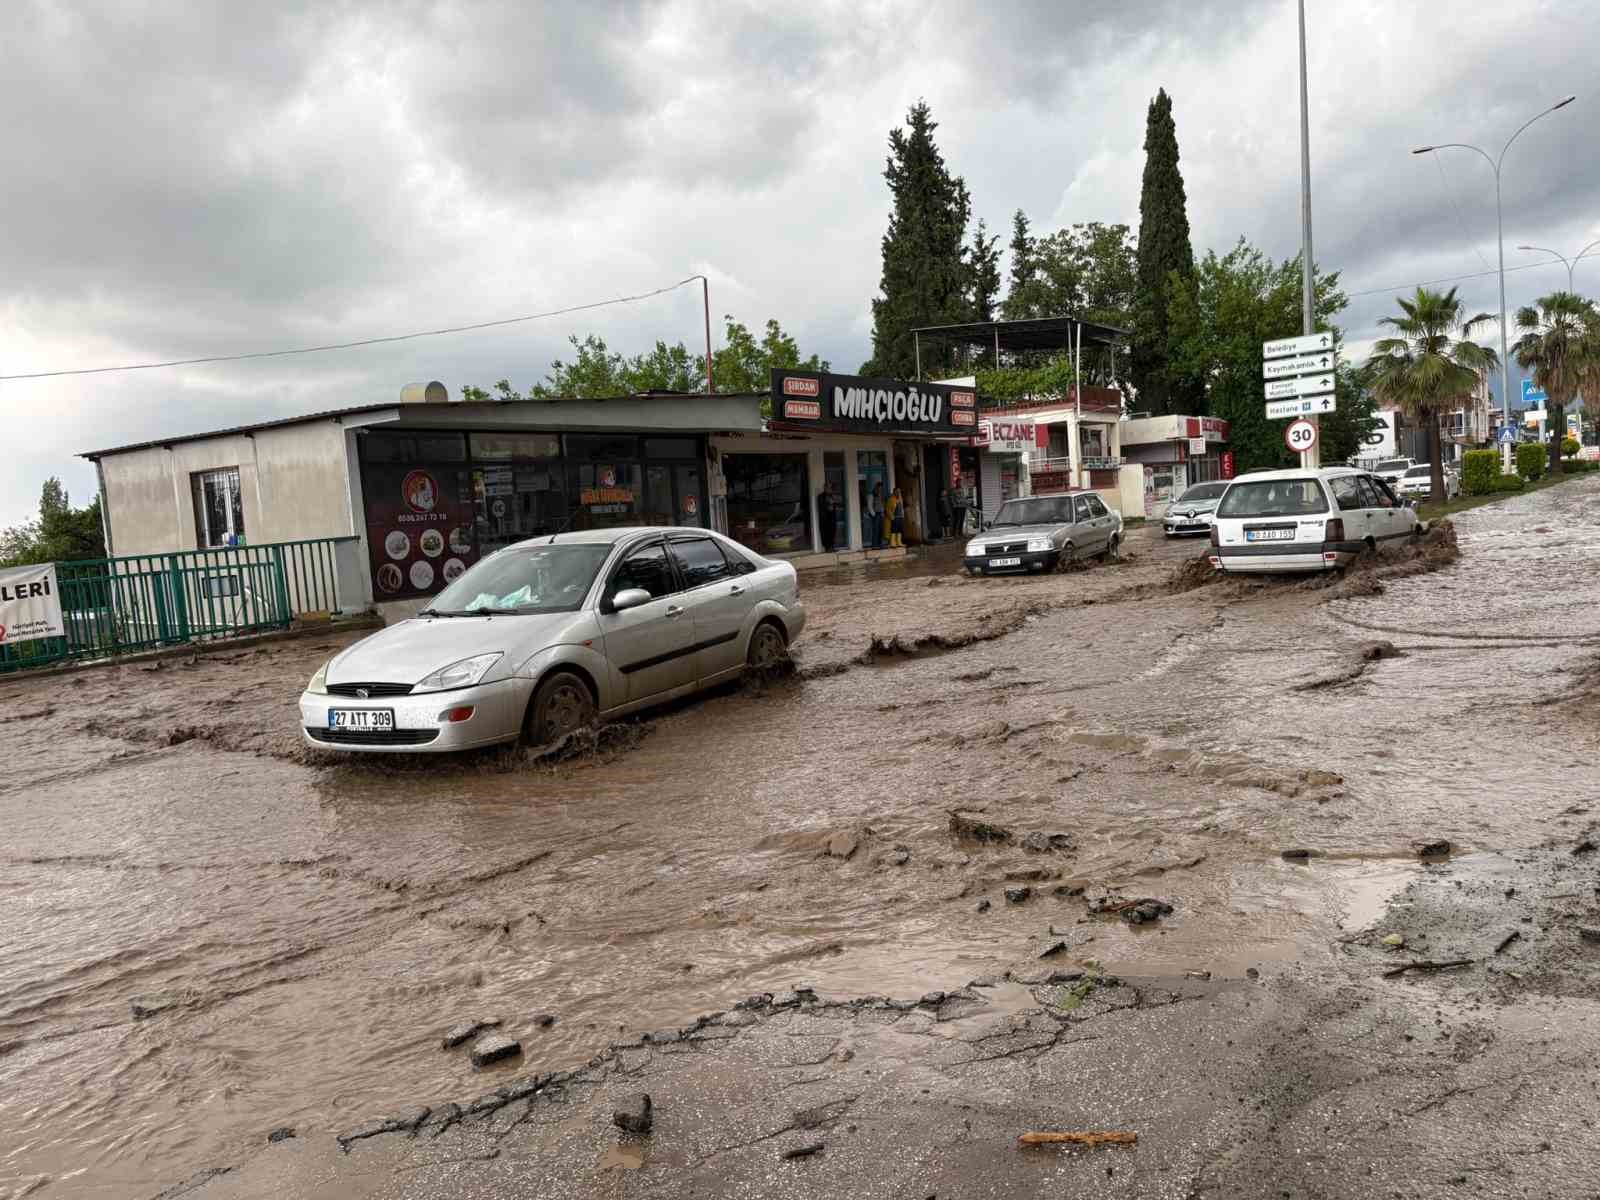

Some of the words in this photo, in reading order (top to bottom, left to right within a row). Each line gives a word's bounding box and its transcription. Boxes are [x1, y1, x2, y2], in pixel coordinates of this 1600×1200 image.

[1267, 344, 1297, 353] Belediye
[834, 386, 941, 423] MIHÇIOĞLU
[993, 423, 1034, 441] ECZANE
[1292, 429, 1311, 442] 30
[335, 711, 347, 726] 27
[350, 711, 368, 726] ATT
[372, 711, 391, 726] 309
